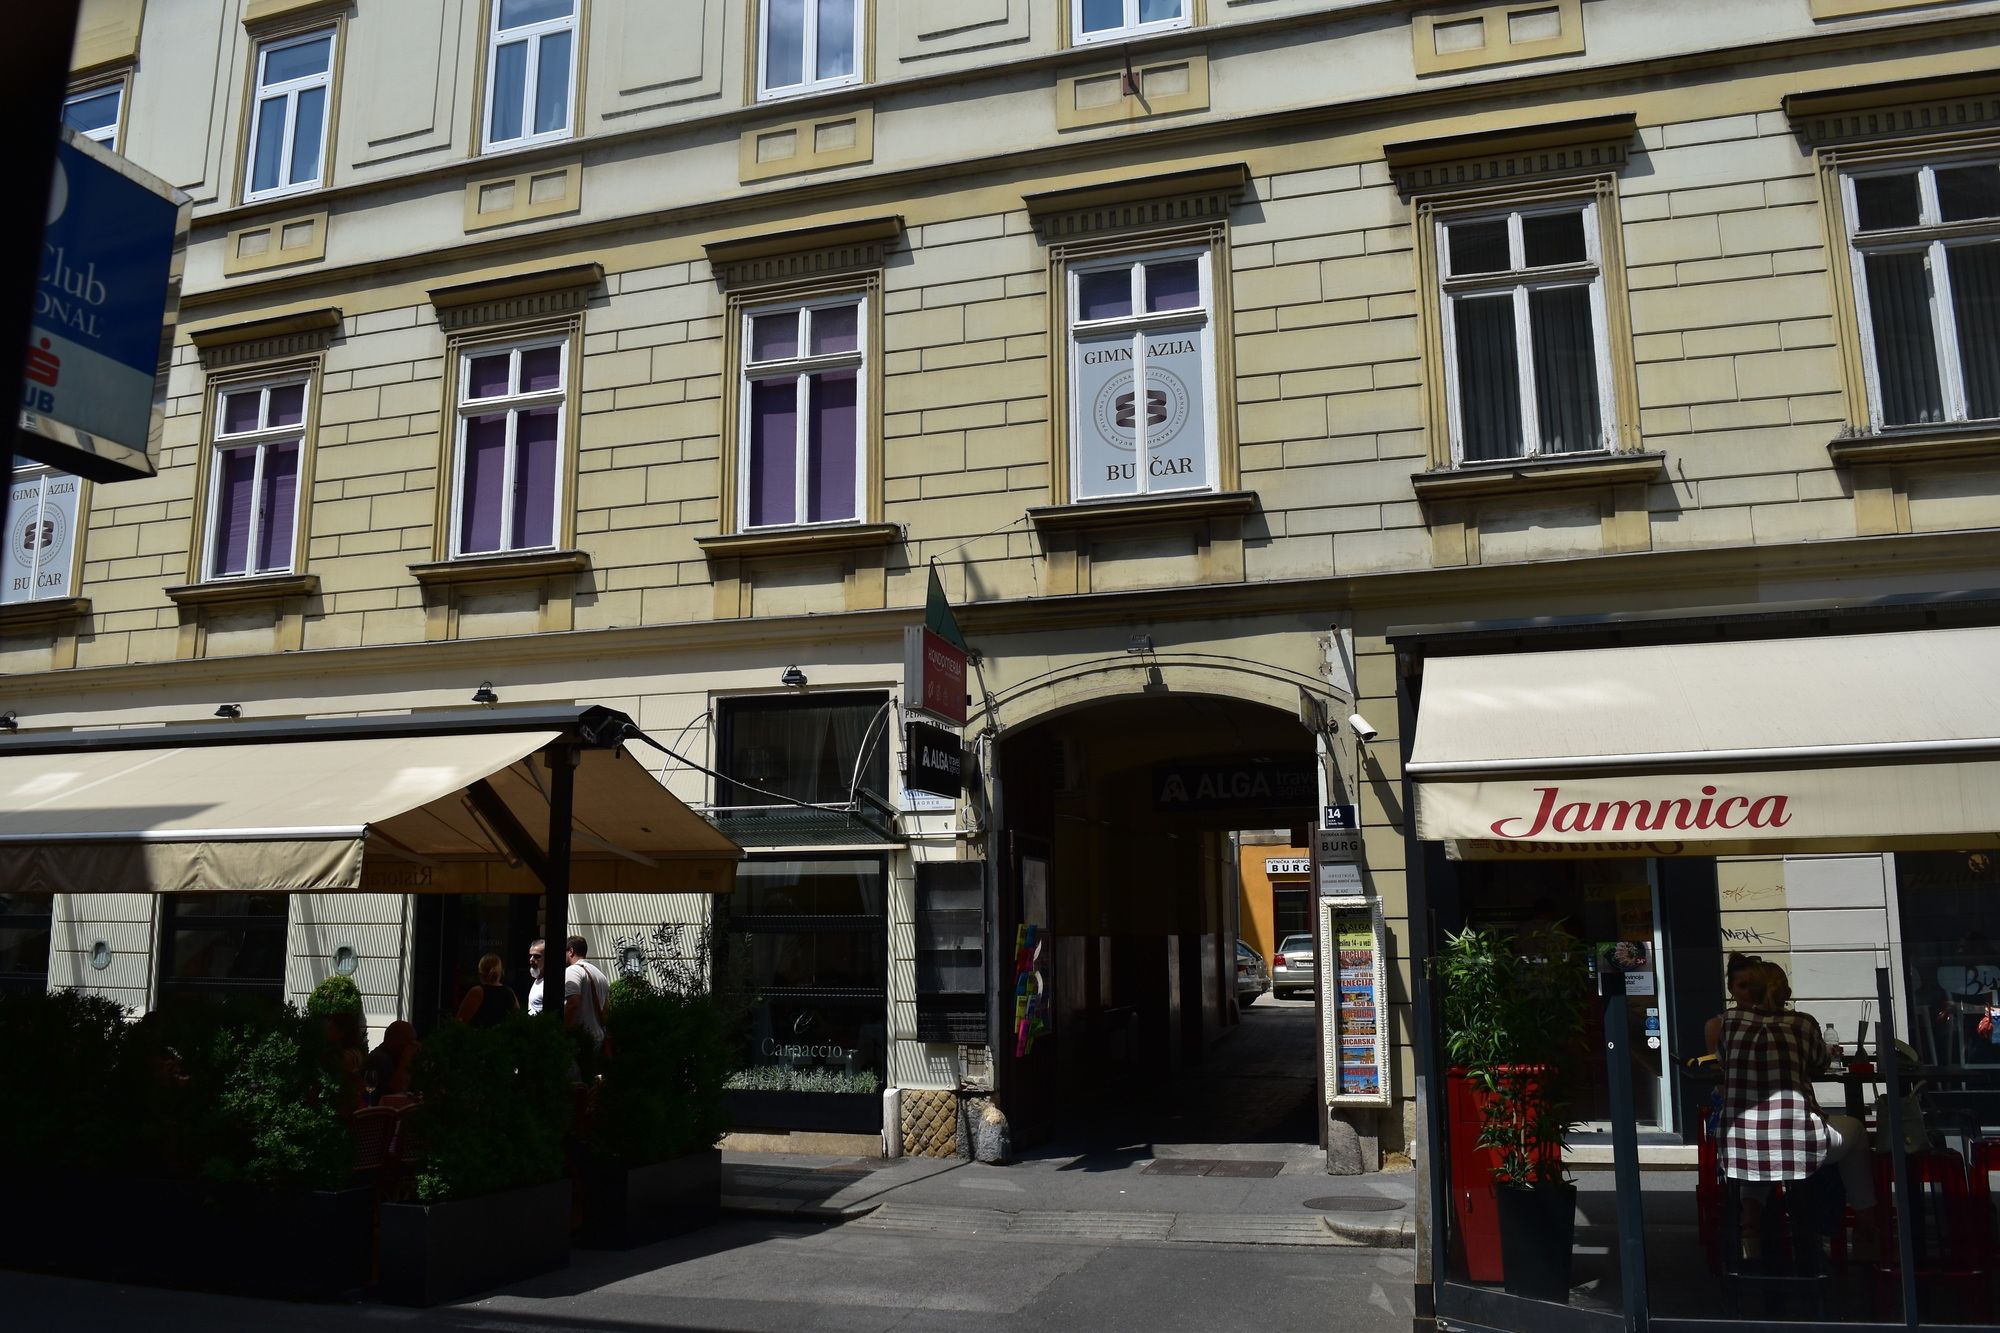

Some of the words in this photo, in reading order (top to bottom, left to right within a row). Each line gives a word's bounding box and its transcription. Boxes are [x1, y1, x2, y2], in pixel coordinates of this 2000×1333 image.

[1084, 340, 1196, 365] GIMNAZIJA
[1106, 456, 1194, 481] BUČAR
[12, 483, 75, 501] GIMNAZIJA
[14, 572, 62, 590] BUČAR
[931, 748, 949, 772] ALGA
[1197, 771, 1272, 799] ALGA
[1327, 809, 1341, 819] 14
[1490, 785, 1792, 838] Jamnica
[1322, 841, 1358, 851] BURG
[1272, 864, 1310, 872] BURG
[1348, 923, 1371, 931] ALGA
[1338, 951, 1372, 960] BARCELONA
[761, 1037, 843, 1062] Carpaccio
